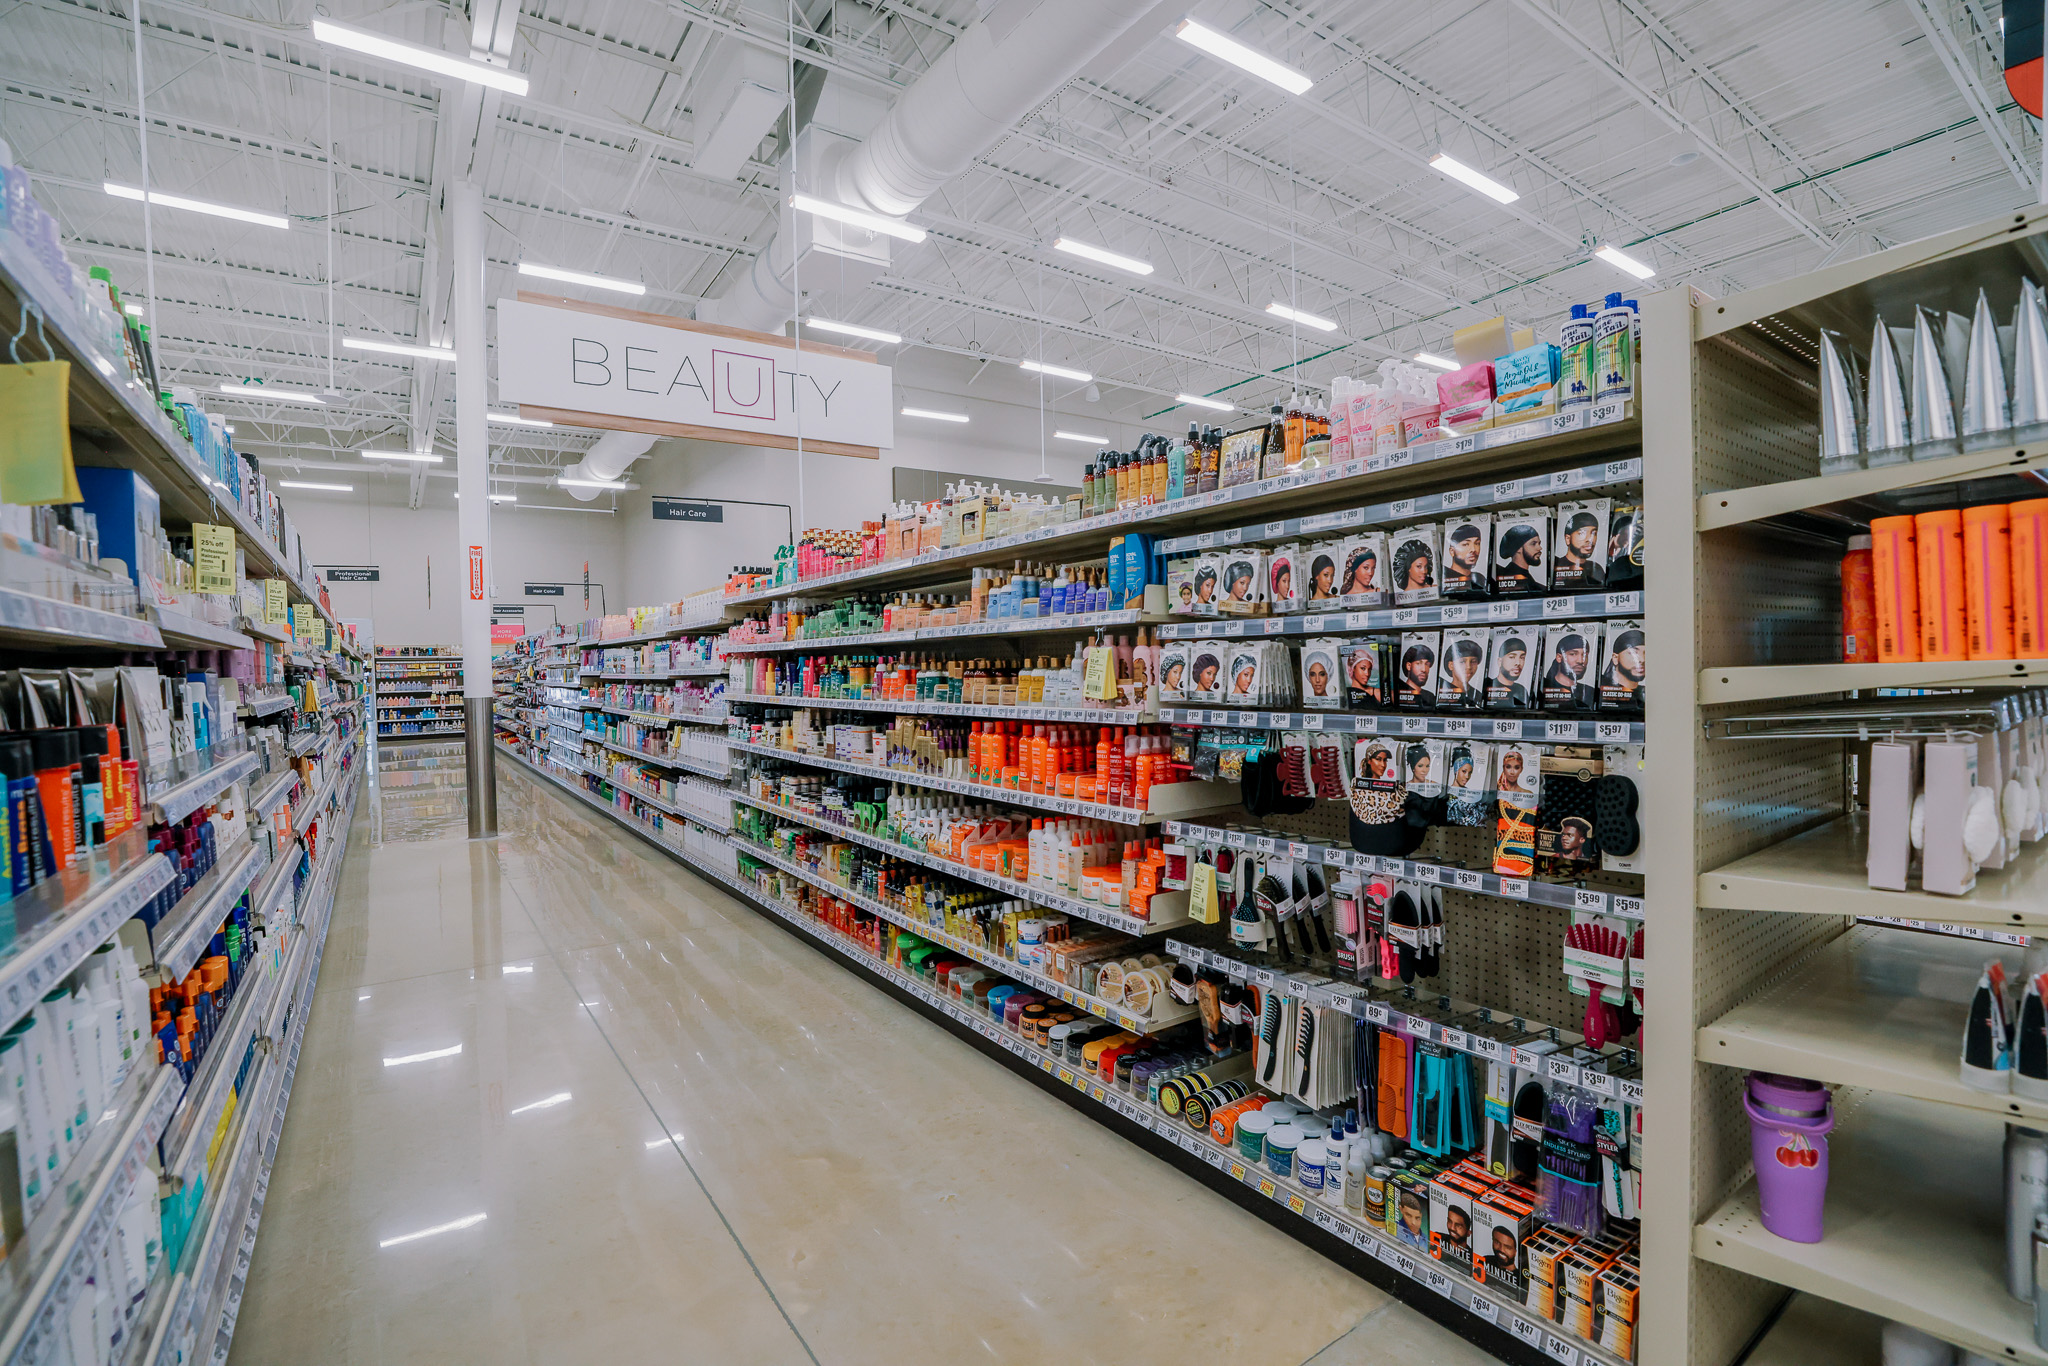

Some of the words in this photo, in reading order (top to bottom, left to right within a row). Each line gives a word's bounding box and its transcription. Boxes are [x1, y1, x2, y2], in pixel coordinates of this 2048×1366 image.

[572, 337, 842, 418] BEAUTY
[1592, 405, 1616, 419] $397
[1554, 413, 1576, 427] $397
[1455, 439, 1473, 450] $179
[1390, 451, 1408, 462] $539
[1607, 462, 1628, 475] $548
[1557, 473, 1568, 484] $2
[1495, 482, 1515, 495] $597
[1443, 492, 1462, 504] $699
[1392, 502, 1408, 512] $597
[688, 510, 707, 518] Care
[201, 539, 214, 547] 25%
[1556, 570, 1573, 578] STRETCH
[1546, 598, 1568, 611] $289
[1609, 594, 1630, 606] $154
[1444, 607, 1463, 618] $599
[1493, 603, 1510, 614] $115
[1352, 614, 1359, 623] $1
[1395, 610, 1412, 621] $699
[1356, 717, 1373, 727] $1199
[1405, 718, 1420, 728] $997
[1447, 720, 1465, 730] $894
[1496, 722, 1516, 732] $697
[1549, 723, 1572, 734] $1197
[1599, 724, 1622, 736] $597
[1208, 828, 1220, 838] $699
[1540, 833, 1556, 842] TWIST
[1539, 839, 1553, 848] KING
[1354, 855, 1371, 865] $347
[1417, 865, 1435, 876] $899
[1458, 872, 1477, 883] $699
[1506, 882, 1521, 891] $1499
[1577, 891, 1600, 904] $599
[1615, 898, 1640, 910] $599
[1337, 951, 1355, 962] BRUSH
[1583, 970, 1601, 978] CONAIR
[1333, 995, 1347, 1006] $297
[1408, 1017, 1424, 1029] $247
[1447, 1032, 1461, 1042] $699
[1477, 1039, 1495, 1051] $419
[1516, 1053, 1531, 1063] $999
[1550, 1061, 1569, 1074] $397
[1584, 1072, 1606, 1085] $397
[1543, 1140, 1567, 1153] ENDLESS
[1567, 1149, 1591, 1160] STYLING
[1596, 1141, 1619, 1153] STYLER
[1430, 1187, 1443, 1200] DARK
[1443, 1193, 1448, 1201] &
[1430, 1194, 1448, 1208] NATURAL
[1473, 1207, 1487, 1220] DARK
[1488, 1213, 1492, 1222] &
[1473, 1215, 1493, 1229] NATURAL
[1357, 1232, 1372, 1245] $427
[1429, 1230, 1442, 1260] 5
[1439, 1239, 1471, 1262] MINUTE
[1396, 1255, 1413, 1270] $449
[1530, 1253, 1552, 1270] Bigen
[1472, 1252, 1486, 1284] 5
[1483, 1261, 1518, 1287] MINUTE
[1428, 1271, 1445, 1286] $694
[1567, 1269, 1590, 1288] Bigen
[1606, 1287, 1630, 1307] Bigen
[1472, 1296, 1490, 1311] $694
[1513, 1319, 1533, 1335] $447
[1549, 1338, 1570, 1355] $447
